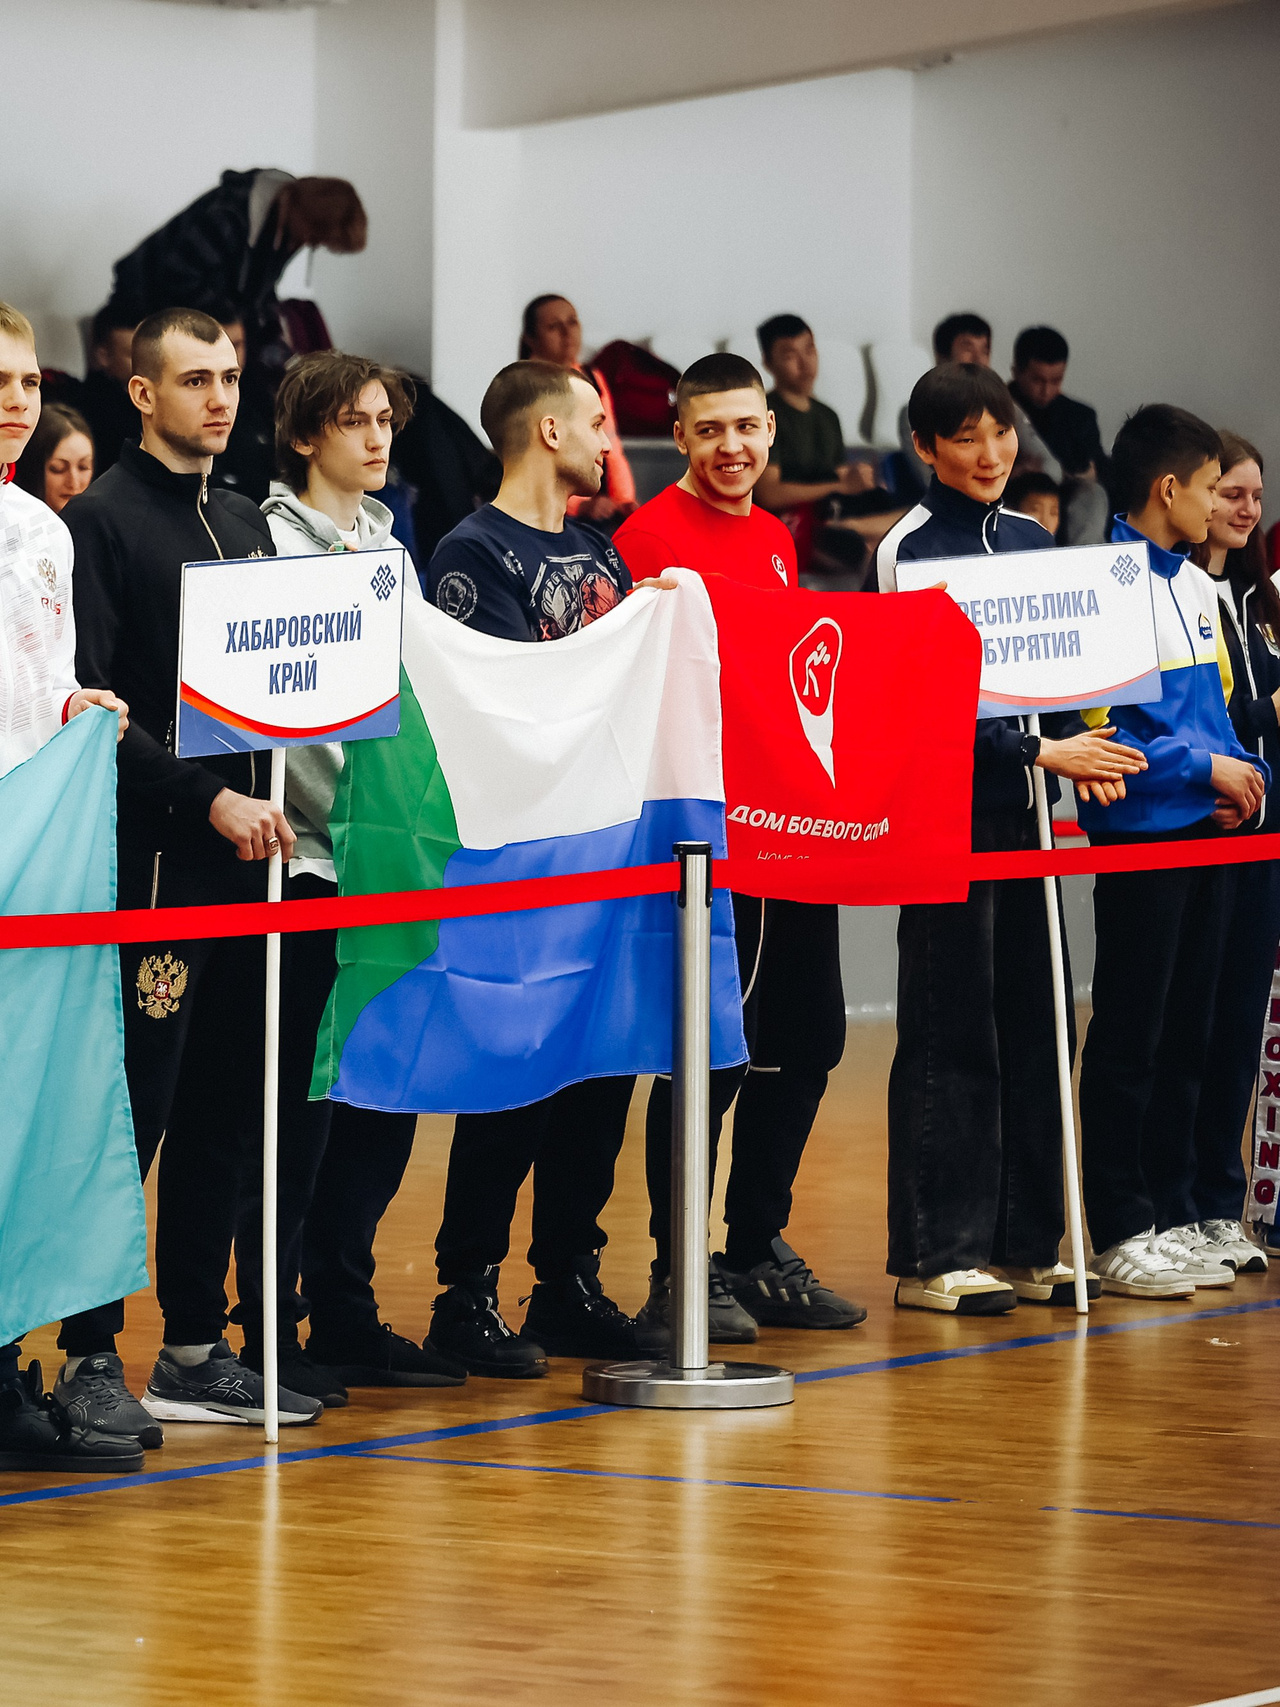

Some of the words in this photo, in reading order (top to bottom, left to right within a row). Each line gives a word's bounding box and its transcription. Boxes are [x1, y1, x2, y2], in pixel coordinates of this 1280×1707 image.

[225, 602, 362, 654] ХАБАРОВСКИЙ
[983, 630, 1081, 666] БУРЯТИЯ
[269, 652, 317, 695] КРАЙ
[727, 805, 786, 832] ДОМ
[786, 815, 862, 841] БОЕВОГО
